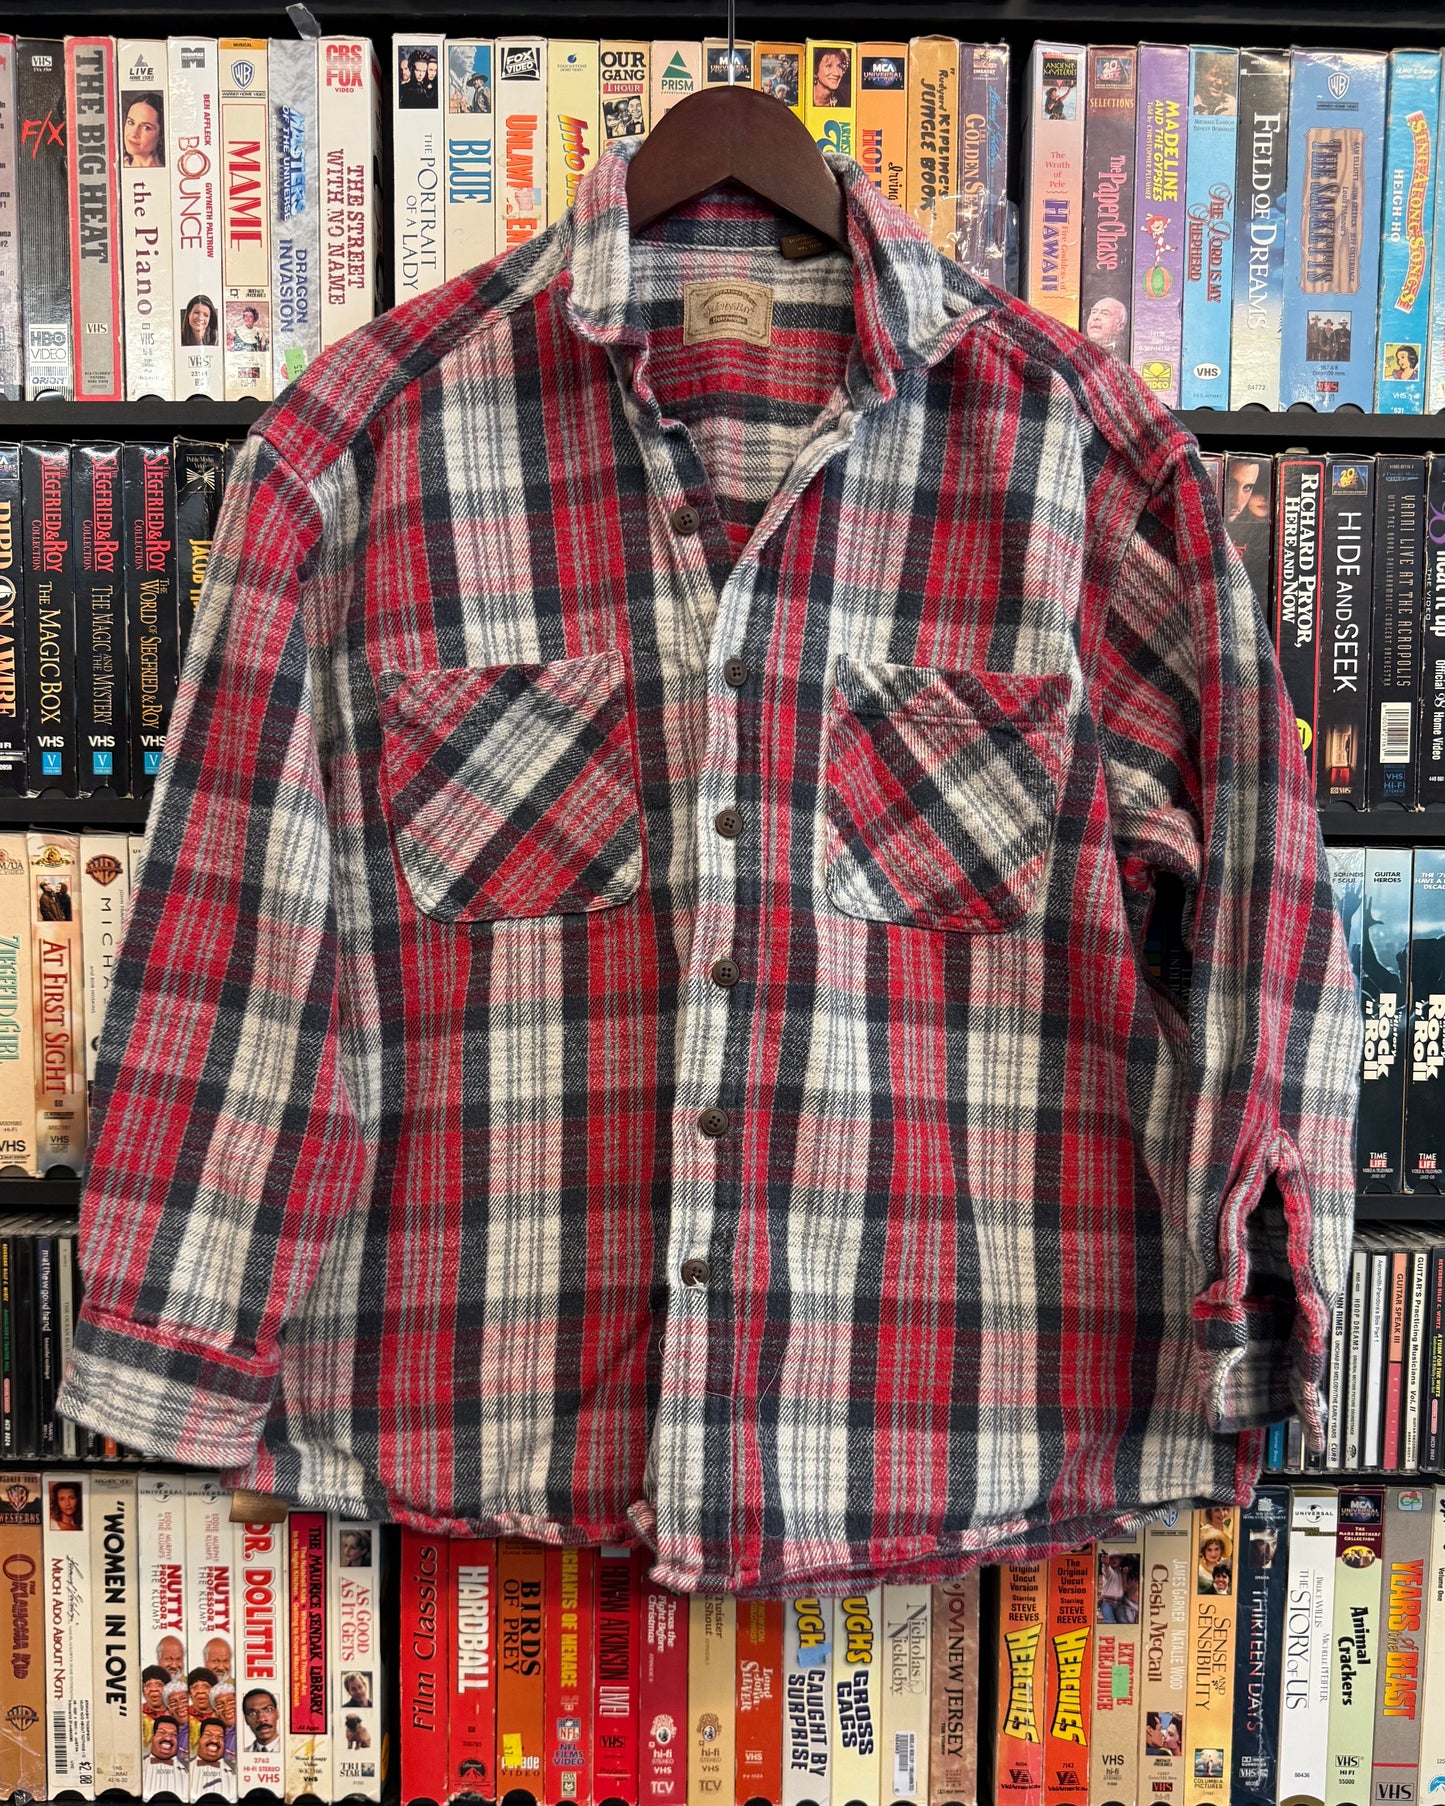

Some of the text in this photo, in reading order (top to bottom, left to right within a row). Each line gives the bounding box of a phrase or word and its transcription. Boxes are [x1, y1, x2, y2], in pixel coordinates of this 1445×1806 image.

[326, 44, 362, 65] CBS
[326, 68, 363, 87] FOX
[506, 62, 534, 73] VIDEO
[507, 50, 533, 65] FOX
[601, 52, 646, 68] OUR
[602, 70, 645, 81] GANG
[661, 80, 694, 91] PRISM
[873, 64, 894, 74] MCA
[21, 110, 65, 160] F/X
[203, 112, 212, 146] AFFLECK
[1090, 98, 1134, 109] SELECTIONS
[76, 50, 109, 264] THE BIG HEAT
[290, 105, 306, 216] MASTERS
[449, 138, 492, 204] BLUE
[888, 162, 903, 200] Irving
[1153, 100, 1164, 202] AND THE GYPSIES
[1163, 100, 1180, 202] MADELINE
[178, 136, 211, 250] BOUNCE
[205, 182, 214, 258] GWYNETH PALTROW
[228, 140, 262, 250] MAME
[327, 149, 346, 304] WITH NO NAME
[347, 165, 365, 288] THE STREET
[417, 133, 438, 269] THE PORTRAIT
[1247, 112, 1280, 331] FIELD OF DREAMS
[1306, 138, 1342, 284] THE SACKETTS
[1391, 169, 1404, 243] HEIGH-HO
[133, 181, 159, 317] the Piano
[402, 195, 419, 291] OF A LADY
[279, 239, 294, 333] INVASION
[296, 250, 308, 324] DRAGON
[30, 331, 66, 347] HBO
[30, 349, 67, 361] VIDEO
[1197, 367, 1218, 376] VHS
[1282, 496, 1300, 625] HERE AND NOW
[1296, 472, 1319, 648] RICHARD PRYOR,
[1395, 494, 1416, 688] YANNI LIVE AT THE ACROPOLIS
[1333, 511, 1362, 694] HIDE AND SEEK
[39, 581, 61, 725] THE MAGIC BOX
[93, 673, 113, 726] MYSTERY
[88, 736, 115, 748] VHS
[43, 941, 64, 968] AT
[43, 971, 68, 1028] FIRST
[44, 1030, 69, 1096] SIGHT
[1370, 1159, 1387, 1167] LIFE
[1335, 1310, 1344, 1336] RIMES
[1394, 1306, 1402, 1334] SPEAK
[1395, 1273, 1403, 1304] GUITAR
[1330, 1443, 1338, 1462] CURB
[0, 1513, 40, 1524] WESTERNS
[1057, 1568, 1088, 1577] Original
[1058, 1586, 1086, 1594] Version
[1061, 1577, 1084, 1585] Uncut
[1065, 1559, 1080, 1567] The
[1388, 1559, 1424, 1632] YEARS
[3, 1553, 36, 1680] OKLAHOMA KID
[166, 1564, 182, 1632] NUTTY
[213, 1566, 230, 1634] NUTTY
[243, 1522, 276, 1680] DR. DOLITTLE
[308, 1526, 324, 1716] THE MAURICE SENDAK LIBRARY
[341, 1576, 357, 1662] AS IT GETS
[356, 1585, 372, 1654] AS GOOD
[457, 1566, 489, 1694] HARDBALL
[503, 1579, 520, 1674] OF PREY
[520, 1580, 541, 1676] BIRDS
[1057, 1615, 1087, 1624] REEVES
[1058, 1606, 1085, 1615] STEVE
[1148, 1564, 1169, 1682] Cash McCall
[1169, 1560, 1187, 1690] JAMES GARNER NATALIE WOOD
[412, 1546, 439, 1732] Film Classics
[906, 1603, 927, 1677] Nicholas
[949, 1635, 964, 1683] NEW
[1195, 1603, 1216, 1711] SENSIBILITY
[1212, 1617, 1231, 1695] SENSE AND
[1246, 1590, 1268, 1731] THIRTEEN DAYS
[1285, 1569, 1311, 1710] THE STORY OF US
[1350, 1606, 1370, 1665] Animal
[1003, 1623, 1043, 1744] HERCULES
[1050, 1625, 1091, 1746] HERCULES
[1097, 1636, 1116, 1711] PREJUDICE
[1337, 1636, 1357, 1706] Crackers
[1383, 1651, 1419, 1720] BEAST
[788, 1673, 808, 1771] SURPRISE
[807, 1669, 828, 1777] CAUGHT BY
[837, 1680, 858, 1748] GAGS
[854, 1669, 874, 1756] GROSS
[944, 1687, 964, 1759] JERSEY
[79, 1761, 91, 1785] $2.00
[257, 1774, 280, 1783] VHS
[651, 1781, 674, 1794] TCV
[654, 1766, 672, 1774] VHS
[1102, 1755, 1124, 1765] VHS
[1336, 1755, 1359, 1767] VHS
[1376, 1782, 1413, 1800] VHS
